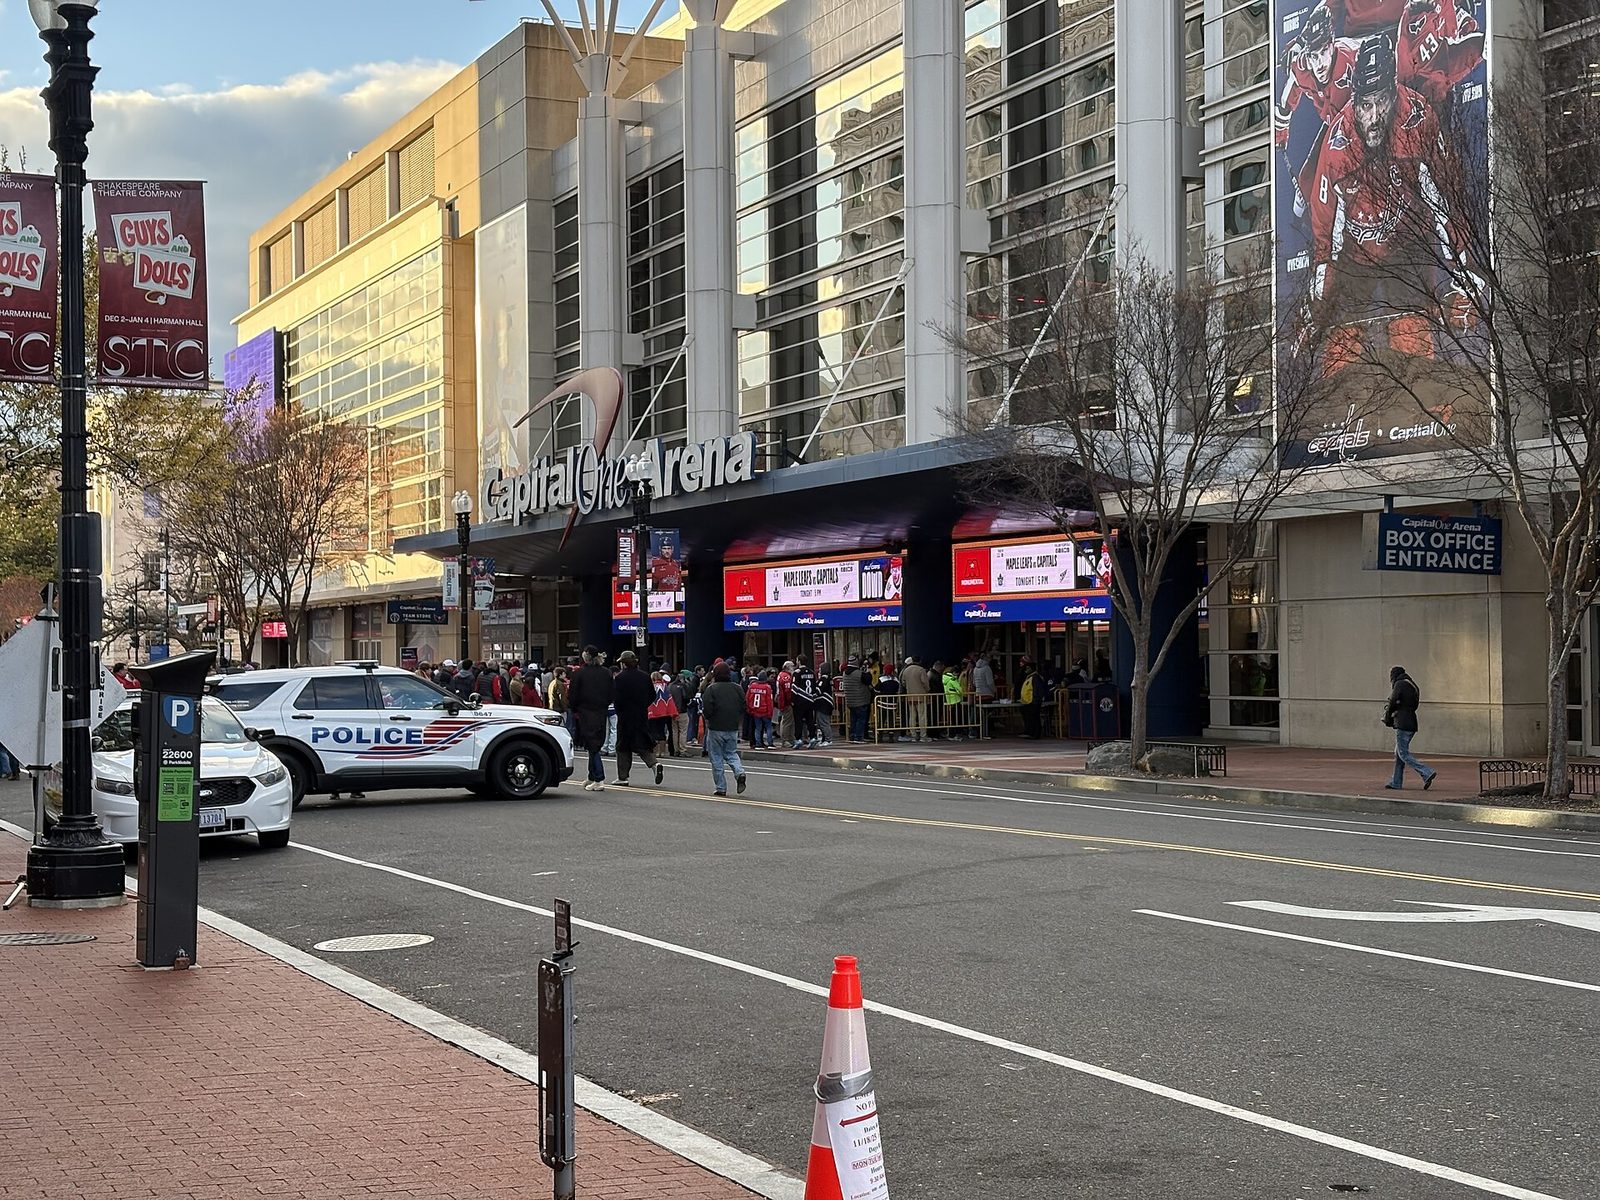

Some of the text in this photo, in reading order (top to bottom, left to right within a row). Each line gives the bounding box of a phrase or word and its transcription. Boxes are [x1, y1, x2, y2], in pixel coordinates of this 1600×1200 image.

[1418, 33, 1440, 62] 43
[97, 182, 160, 190] SHAKESPEARE
[138, 190, 183, 198] COMPANY
[1319, 174, 1329, 204] 8
[19, 235, 39, 243] AND
[119, 218, 170, 247] GUYS
[171, 245, 189, 253] AND
[0, 252, 40, 282] OLLS
[138, 253, 191, 290] DOLLS
[32, 311, 51, 319] HALL
[153, 317, 185, 325] HARMAN
[186, 319, 203, 327] HALL
[101, 335, 204, 382] STC
[642, 431, 757, 500] Arena
[1452, 522, 1482, 532] Arena
[1386, 530, 1496, 551] BOX OFFICE
[618, 536, 632, 578] CHYCHRUN
[1005, 556, 1020, 571] MAPLE
[1019, 555, 1033, 570] LEAFS
[1036, 554, 1058, 568] CAPITALS
[1385, 549, 1494, 570] ENTRANCE
[783, 571, 799, 588] MAPLE
[798, 569, 812, 586] LEAFS
[816, 567, 839, 585] CAPITALS
[1015, 575, 1035, 586] TONIGHT
[97, 670, 106, 719] SUNRISE
[805, 679, 812, 695] 8
[753, 693, 760, 708] 8
[171, 699, 190, 727] P
[311, 727, 423, 744] POLICE
[162, 750, 193, 759] 22600
[856, 1102, 868, 1112] NO
[852, 1160, 868, 1170] MON
